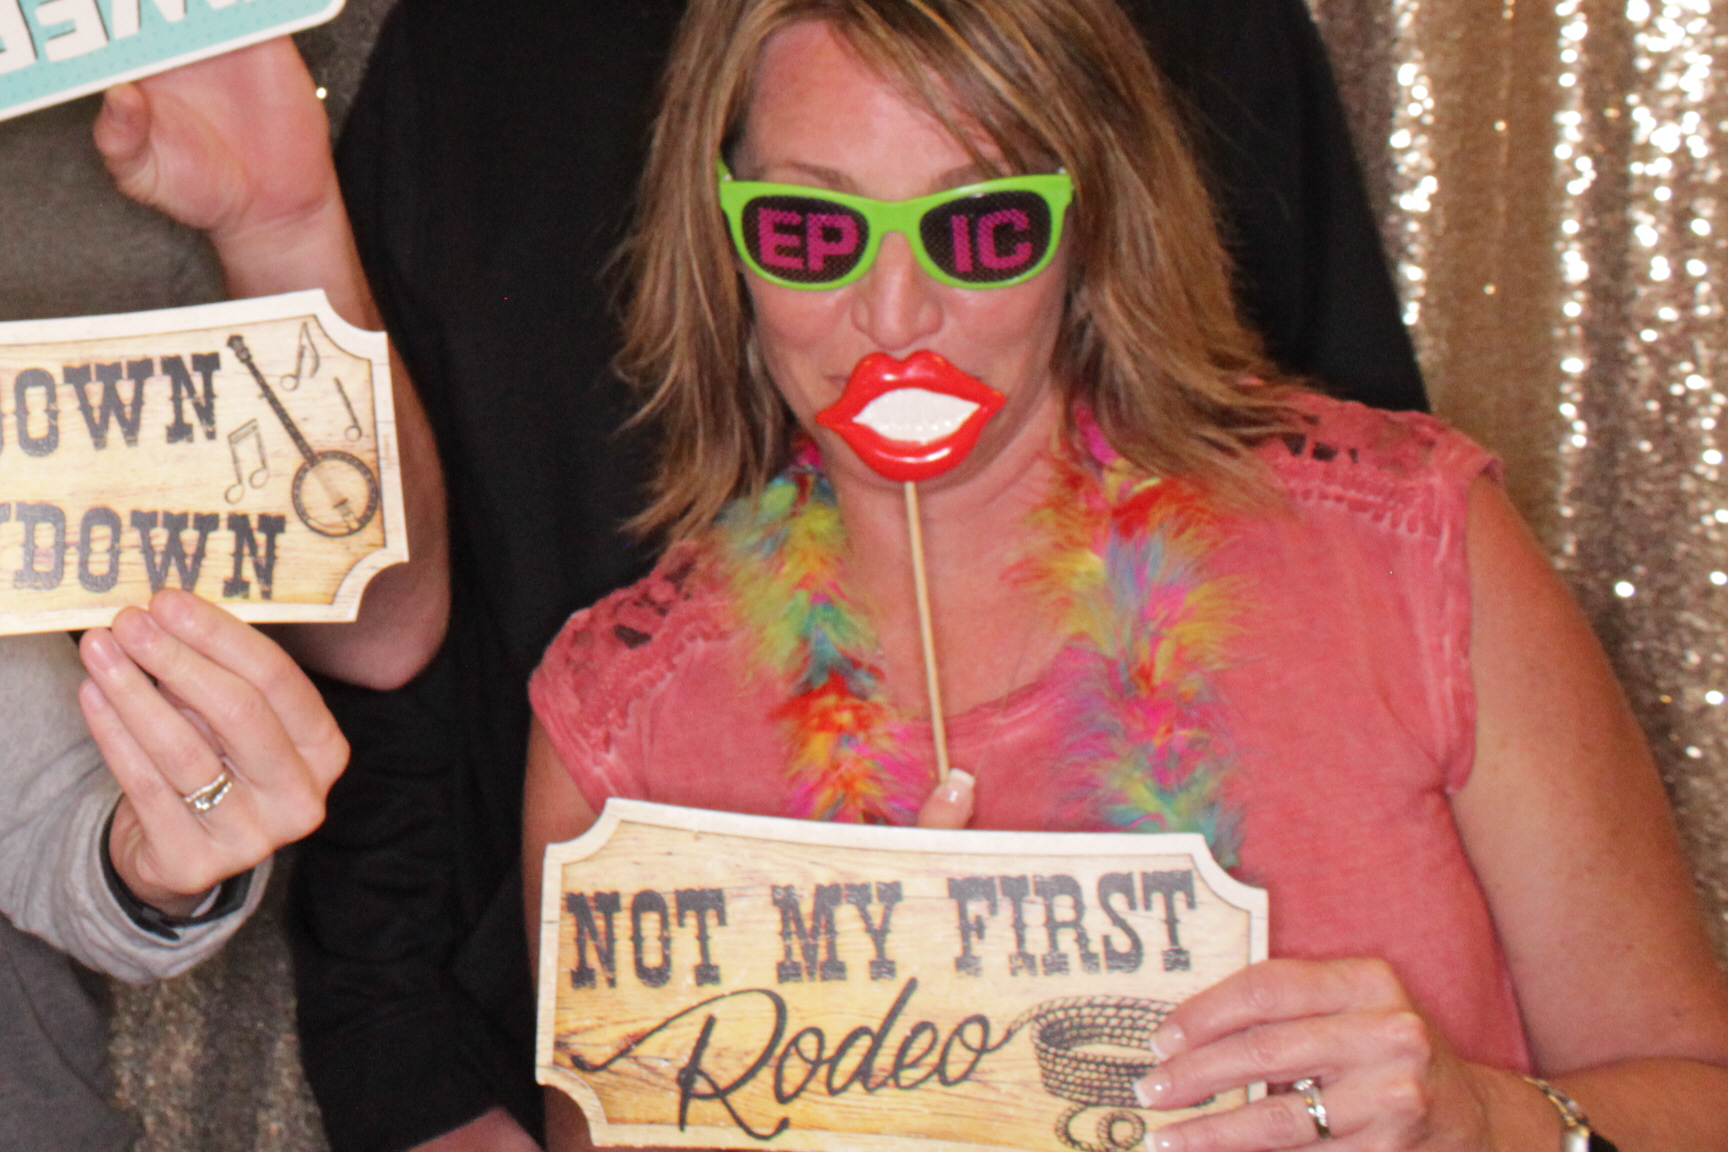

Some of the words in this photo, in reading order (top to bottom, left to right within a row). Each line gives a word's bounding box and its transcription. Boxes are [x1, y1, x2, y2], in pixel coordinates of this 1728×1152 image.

[565, 887, 727, 990] NOT
[771, 880, 903, 984] MY
[947, 869, 1198, 978] FIRST
[555, 977, 996, 1140] Rodeo
